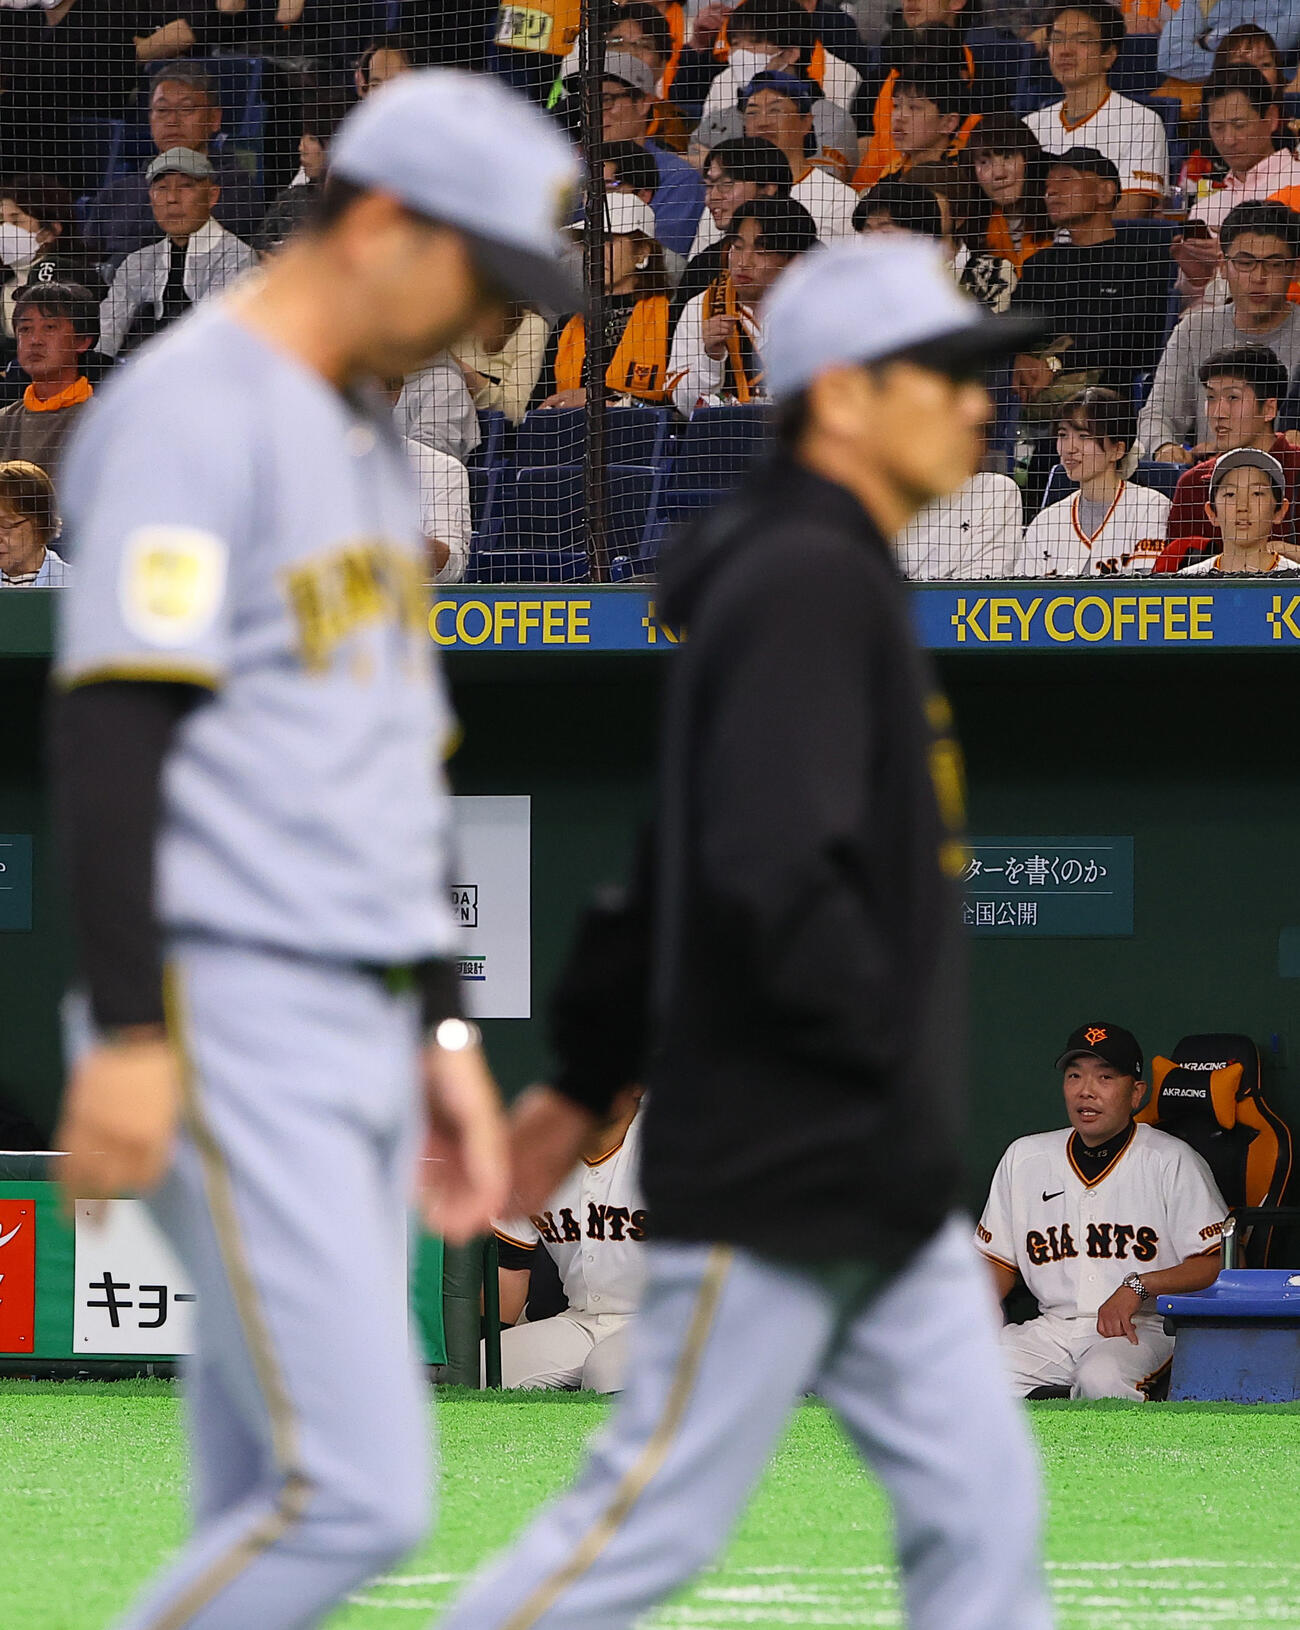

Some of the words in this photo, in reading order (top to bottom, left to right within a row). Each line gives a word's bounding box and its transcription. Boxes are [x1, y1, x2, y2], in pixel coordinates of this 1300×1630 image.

[427, 600, 591, 646] COFFEE
[960, 854, 1108, 886] ターを書くのか
[1162, 1088, 1206, 1098] AKRACING
[1025, 1222, 1159, 1266] GIANTS
